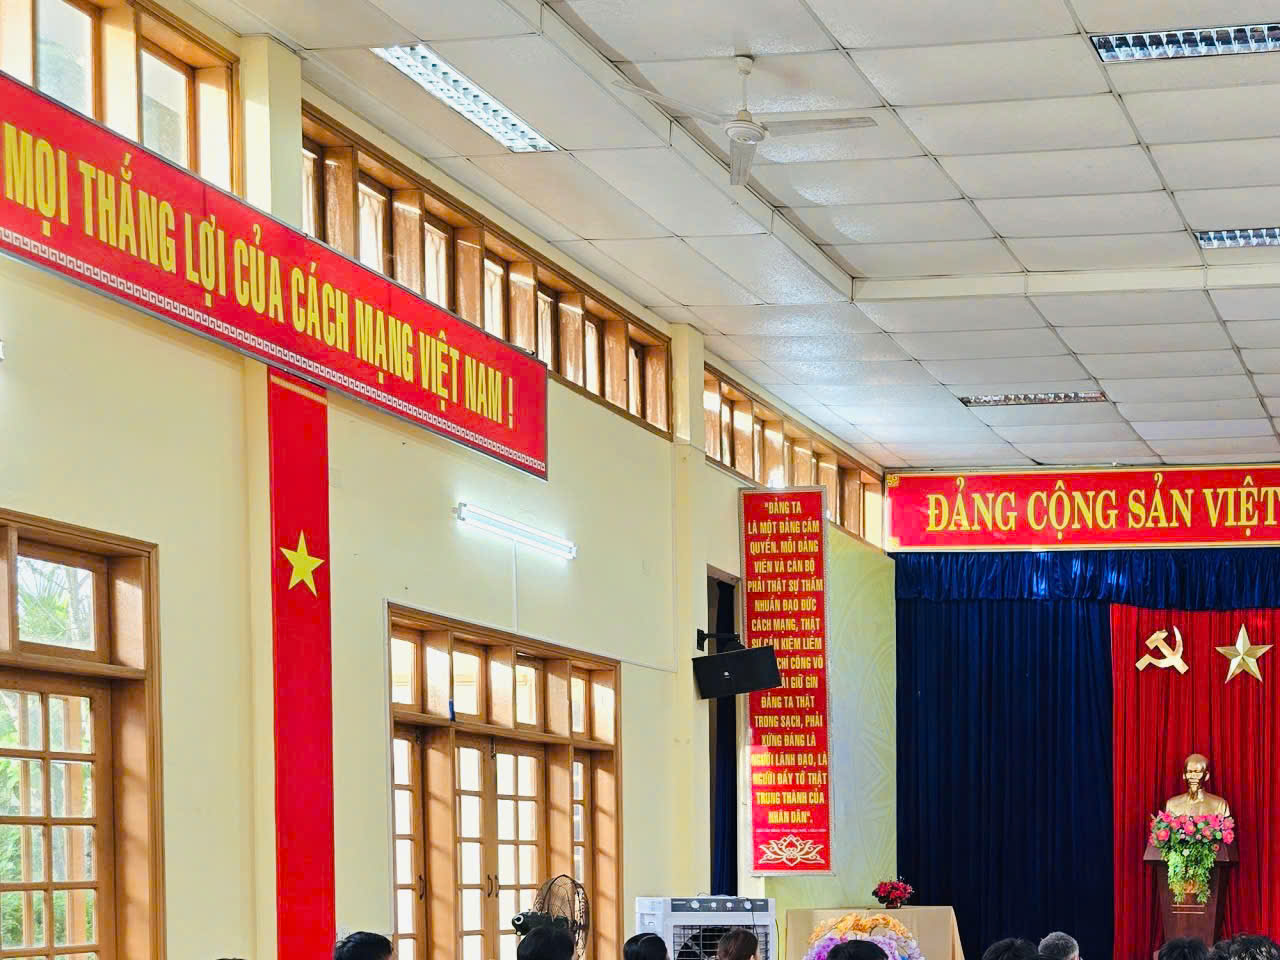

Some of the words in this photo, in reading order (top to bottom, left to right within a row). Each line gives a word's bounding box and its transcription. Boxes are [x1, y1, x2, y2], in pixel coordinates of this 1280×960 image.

[3, 122, 69, 237] MỌI
[78, 152, 176, 272] THẮNG
[184, 212, 226, 307] LỢI
[233, 223, 285, 324] CỦA
[291, 261, 349, 353] CÁCH
[355, 298, 414, 384] MẠNG
[419, 330, 460, 411] VIỆT
[464, 355, 502, 424] NAM
[791, 501, 802, 513] TA
[926, 477, 1016, 531] ĐẢNG
[1027, 480, 1117, 539] CỘNG
[1128, 472, 1194, 528] SẢN
[1203, 475, 1280, 536] VIỆT
[748, 520, 757, 534] LÀ
[760, 520, 777, 536] MỘT
[779, 517, 800, 533] ĐẢNG
[798, 536, 818, 552] ĐẢNG
[754, 558, 772, 573] VIÊN
[775, 558, 784, 572] VÀ
[787, 557, 802, 572] CÁN
[805, 557, 815, 574] BỘ
[761, 692, 782, 708] ĐẢNG
[783, 696, 794, 708] TA
[795, 693, 815, 710] THẬT
[754, 715, 779, 728] TRONG
[780, 715, 803, 730] SẠCH,
[805, 711, 823, 727] PHẢI
